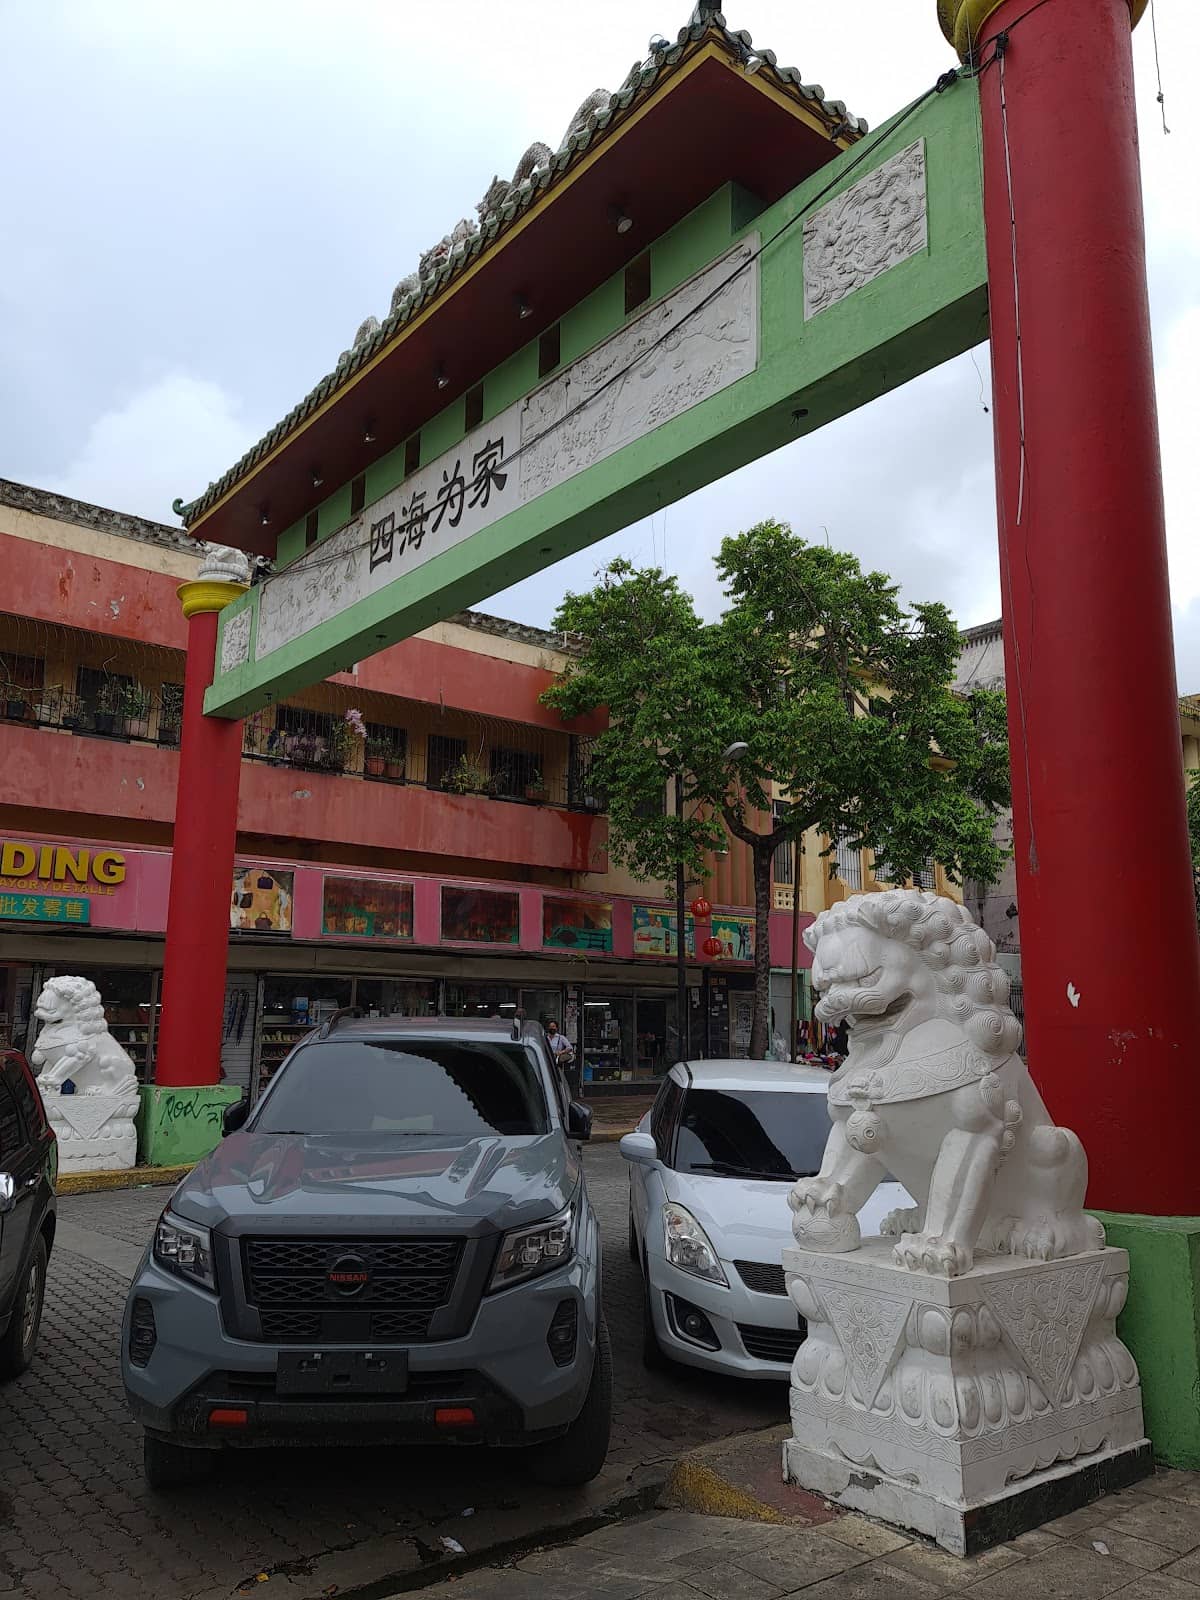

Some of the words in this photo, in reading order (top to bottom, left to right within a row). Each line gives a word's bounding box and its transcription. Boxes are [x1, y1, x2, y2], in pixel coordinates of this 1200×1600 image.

[369, 436, 508, 575] 四海为家
[1, 842, 126, 884] DING
[41, 880, 50, 890] Y
[52, 882, 115, 896] DETALLE
[0, 896, 84, 918] 批发零售
[329, 1273, 367, 1281] NISSAN
